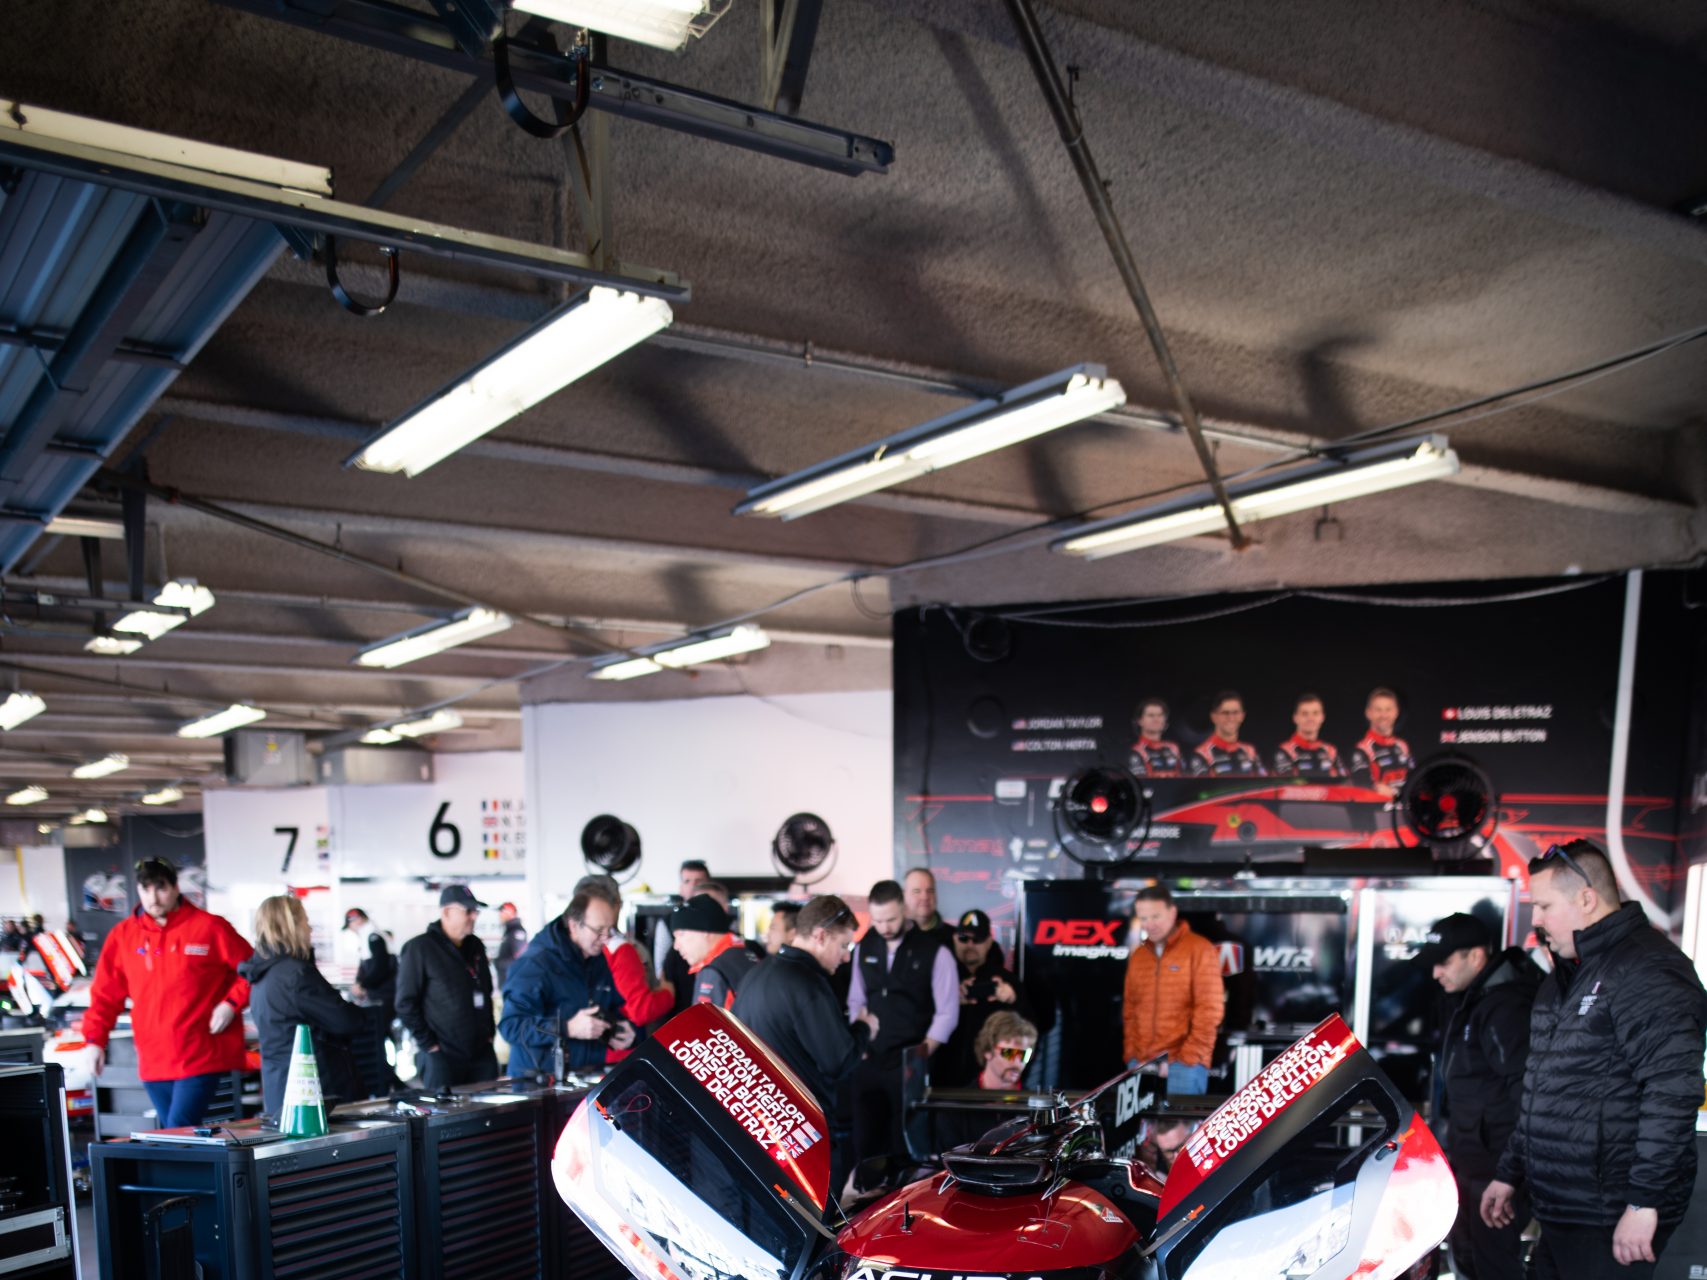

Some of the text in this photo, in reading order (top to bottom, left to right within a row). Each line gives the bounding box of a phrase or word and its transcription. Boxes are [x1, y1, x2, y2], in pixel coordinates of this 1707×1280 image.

[1457, 704, 1552, 720] LOUIS DELETRAZ
[1458, 728, 1547, 743] JENSON BUTTON
[274, 827, 299, 873] 7
[429, 801, 461, 859] 6
[1033, 919, 1121, 945] DEX
[1053, 943, 1130, 960] imaging
[1253, 946, 1314, 968] WTR
[668, 1039, 775, 1150] LOUIS DELETRAZ
[684, 1038, 787, 1140] JENSON BUTTON
[705, 1037, 795, 1131] COLTON HERTA
[709, 1028, 806, 1124] JORDAN TAYLOR
[1115, 1072, 1142, 1128] DEX
[1214, 1092, 1271, 1148] JENSON
[1269, 1040, 1333, 1096] BUTTON
[1215, 1045, 1347, 1158] LOUIS DELETRAZ
